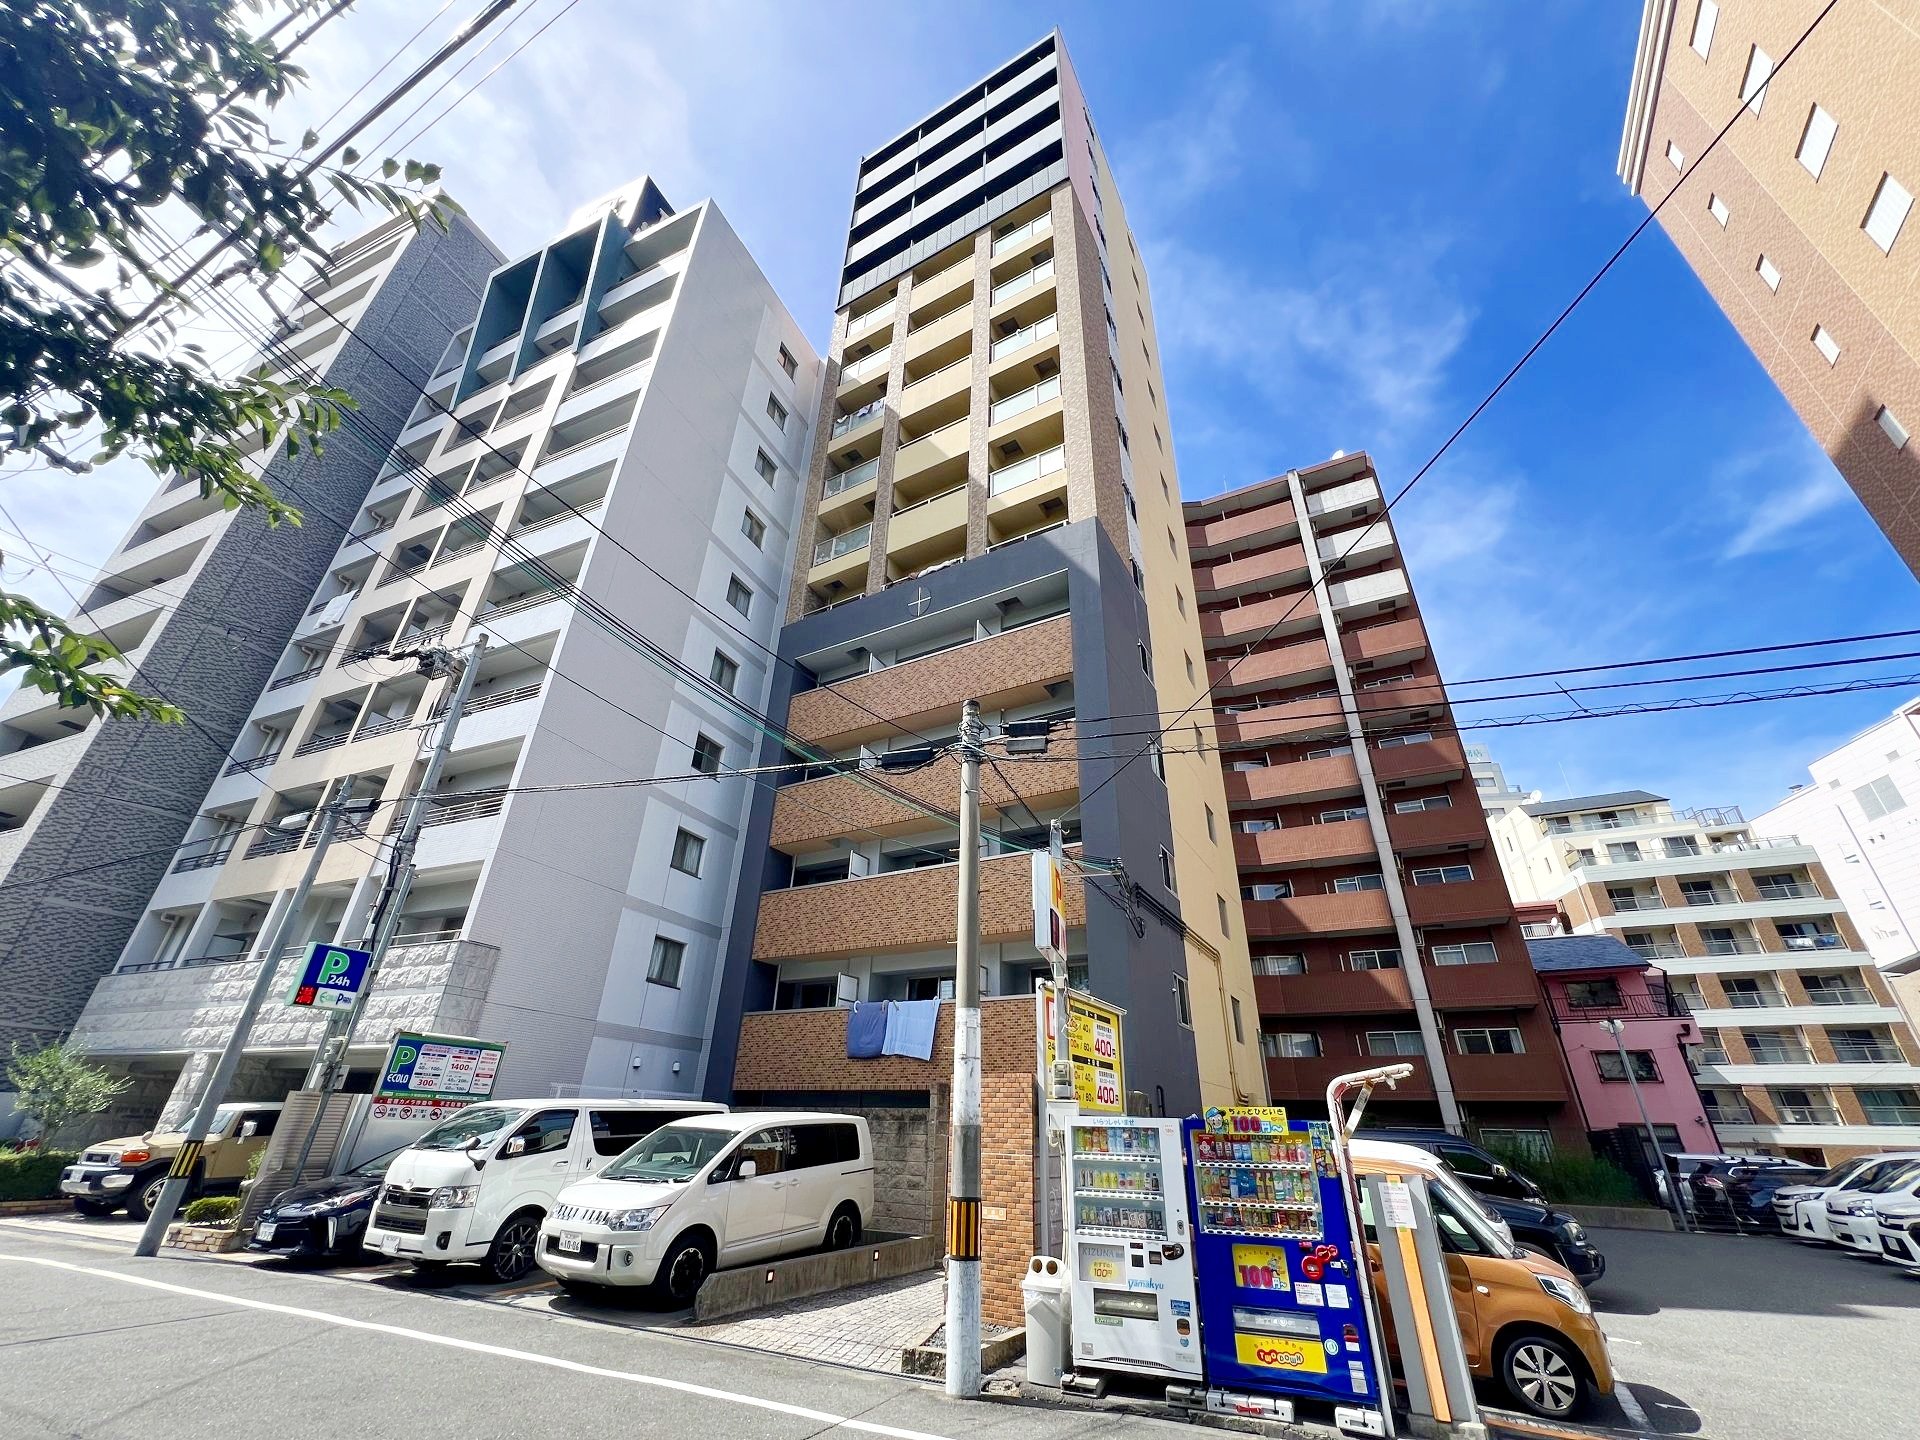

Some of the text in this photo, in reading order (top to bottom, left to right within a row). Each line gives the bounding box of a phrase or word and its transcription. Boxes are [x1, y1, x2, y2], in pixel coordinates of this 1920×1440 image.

[317, 950, 350, 984] P
[328, 975, 350, 987] 24h
[390, 1046, 416, 1073] P
[1093, 1118, 1134, 1126] いらっしゃいませ
[1082, 1247, 1114, 1257] KIZUNA
[1128, 1278, 1164, 1290] yamakyu
